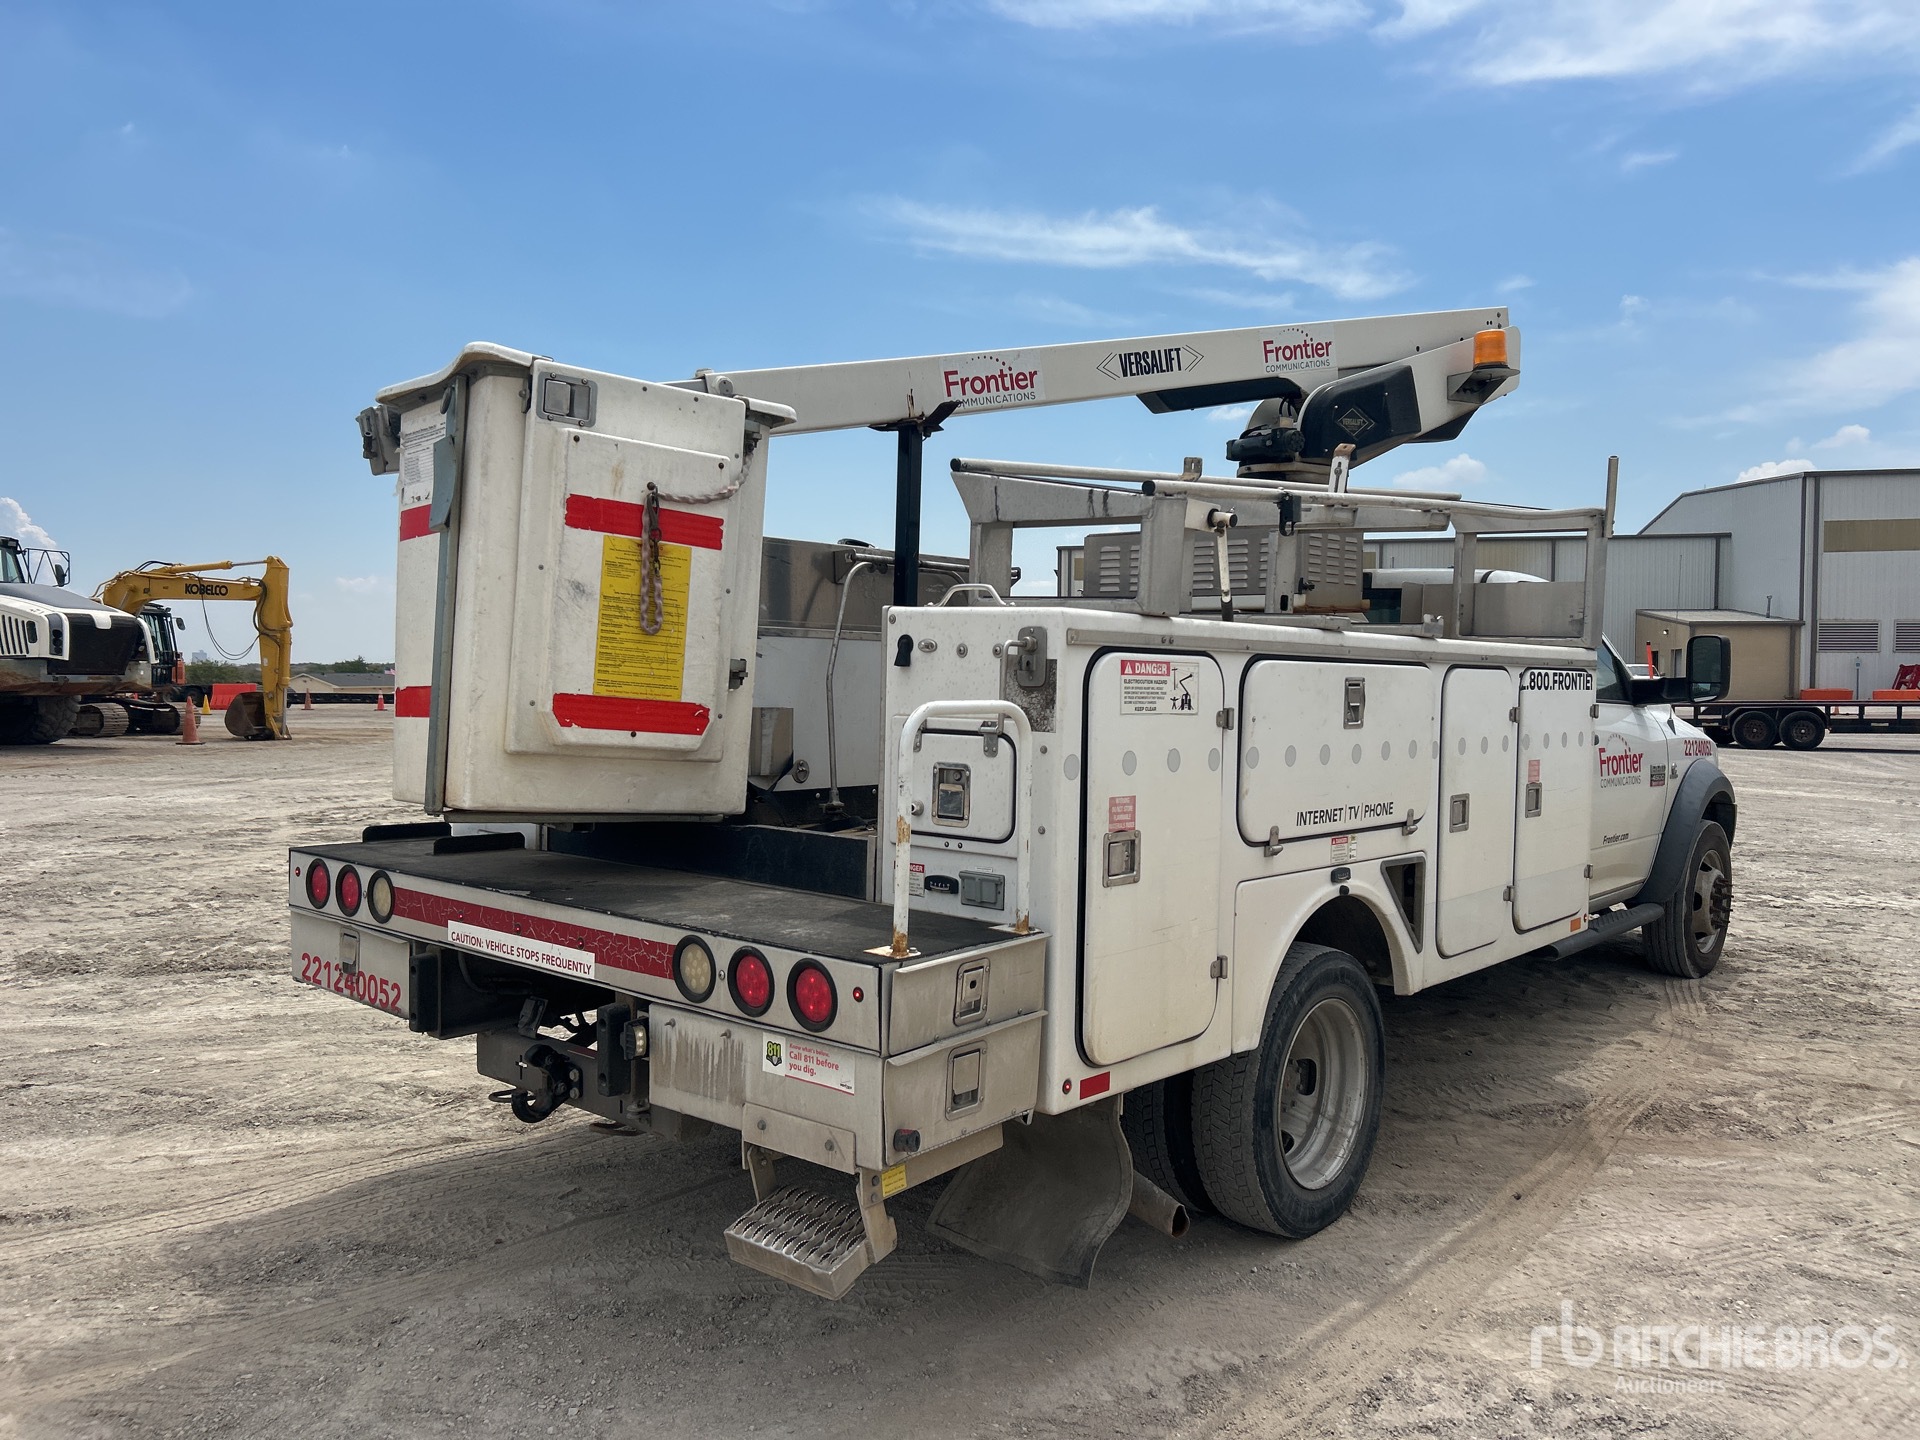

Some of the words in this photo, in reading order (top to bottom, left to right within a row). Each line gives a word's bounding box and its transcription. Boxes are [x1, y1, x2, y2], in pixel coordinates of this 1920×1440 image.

[1263, 338, 1332, 363] Frontier
[1118, 347, 1182, 378] VERSALIFT
[1265, 359, 1331, 373] COMMUNICATIONS
[943, 366, 1038, 397] Frontier
[185, 583, 228, 596] KOBELCO
[1135, 662, 1168, 675] DANGER
[1599, 747, 1644, 777] Frontier
[1600, 775, 1641, 788] COMMUNICATIONS
[1296, 807, 1344, 827] INTERNET
[1348, 806, 1360, 820] TV
[1364, 801, 1394, 818] PHONE
[1603, 832, 1629, 845] Frontier.com
[451, 931, 484, 948] CAUTION:
[485, 939, 515, 956] VEHICLE
[516, 947, 540, 962] STOPS
[541, 954, 592, 975] FREQUENTLY
[301, 952, 402, 1014] 221240052
[767, 1041, 781, 1057] 811
[789, 1043, 802, 1051] Know
[789, 1051, 802, 1062] Call
[803, 1054, 815, 1064] 811
[815, 1057, 839, 1070] before
[789, 1062, 802, 1071] you
[803, 1065, 817, 1076] dig.
